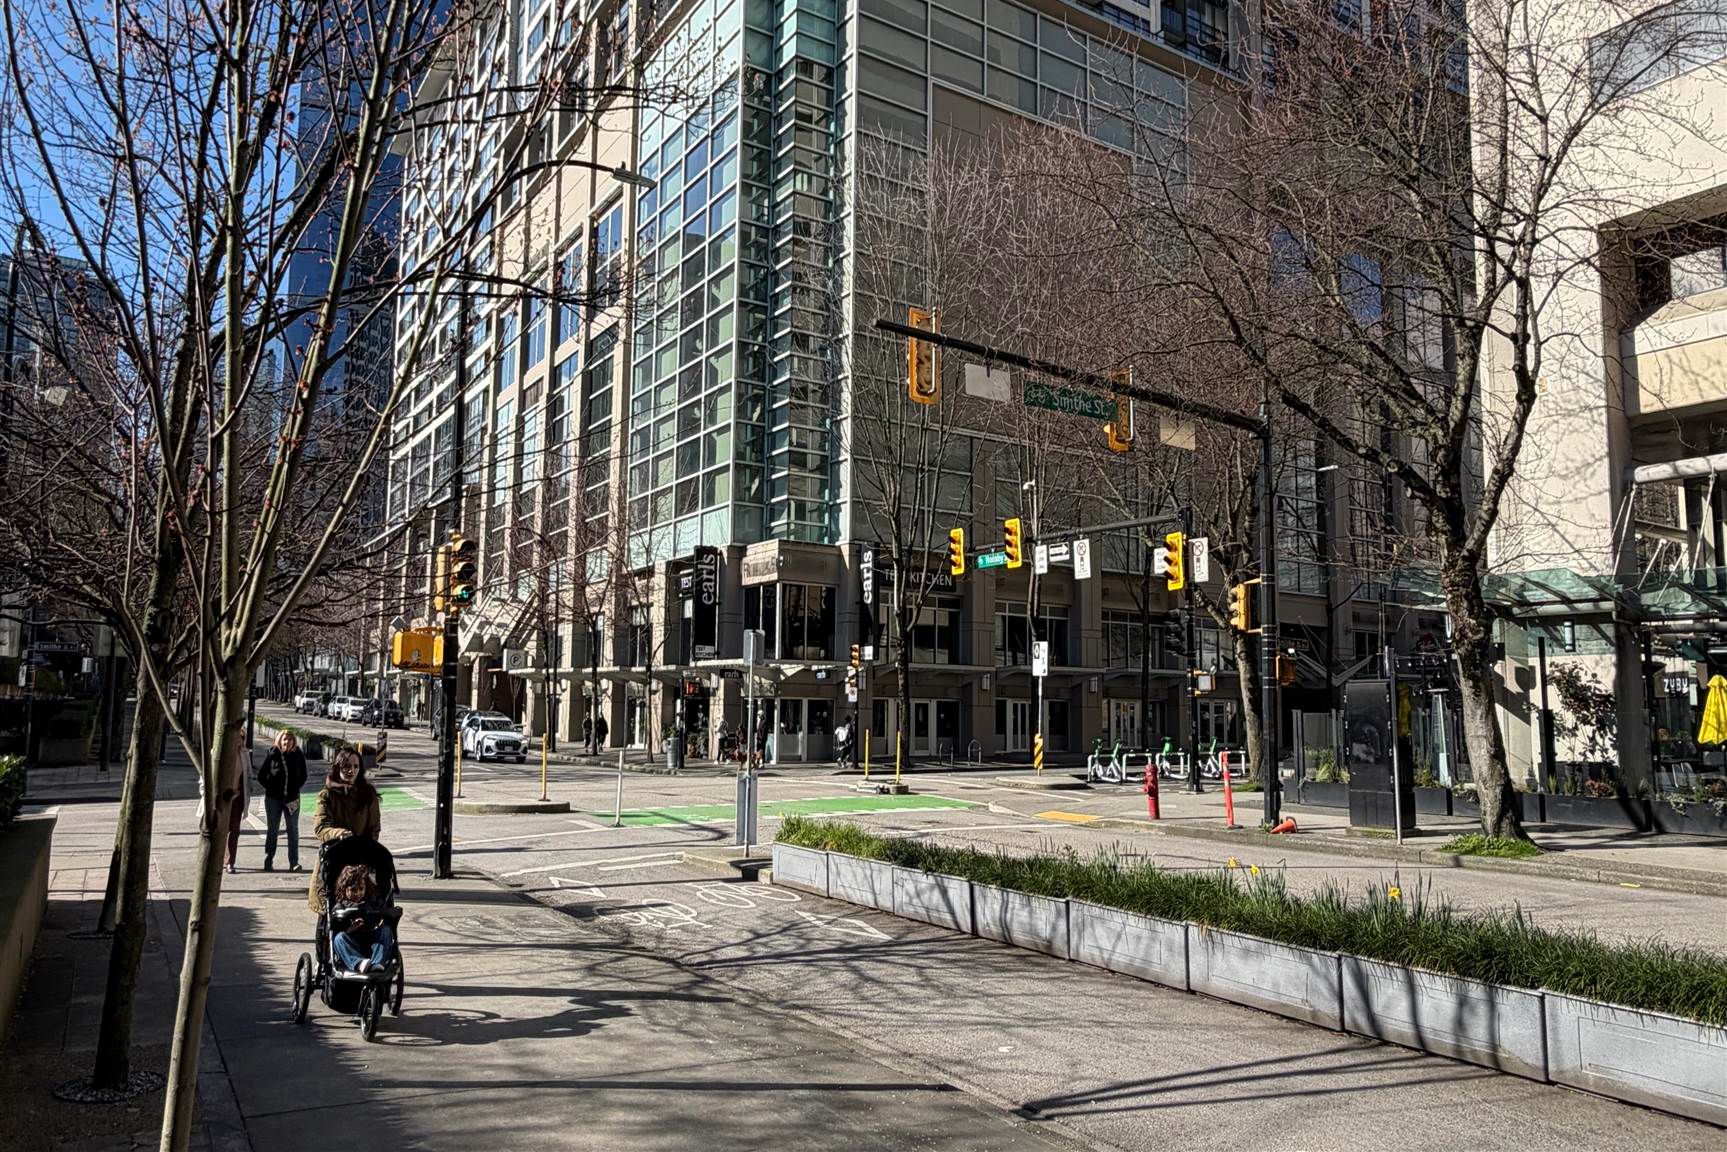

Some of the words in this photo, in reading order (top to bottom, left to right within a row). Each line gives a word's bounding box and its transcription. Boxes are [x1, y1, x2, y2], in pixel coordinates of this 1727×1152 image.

[1053, 391, 1092, 412] Smithe
[698, 554, 715, 605] earls
[860, 551, 872, 604] earls
[911, 571, 952, 586] KITCHEN
